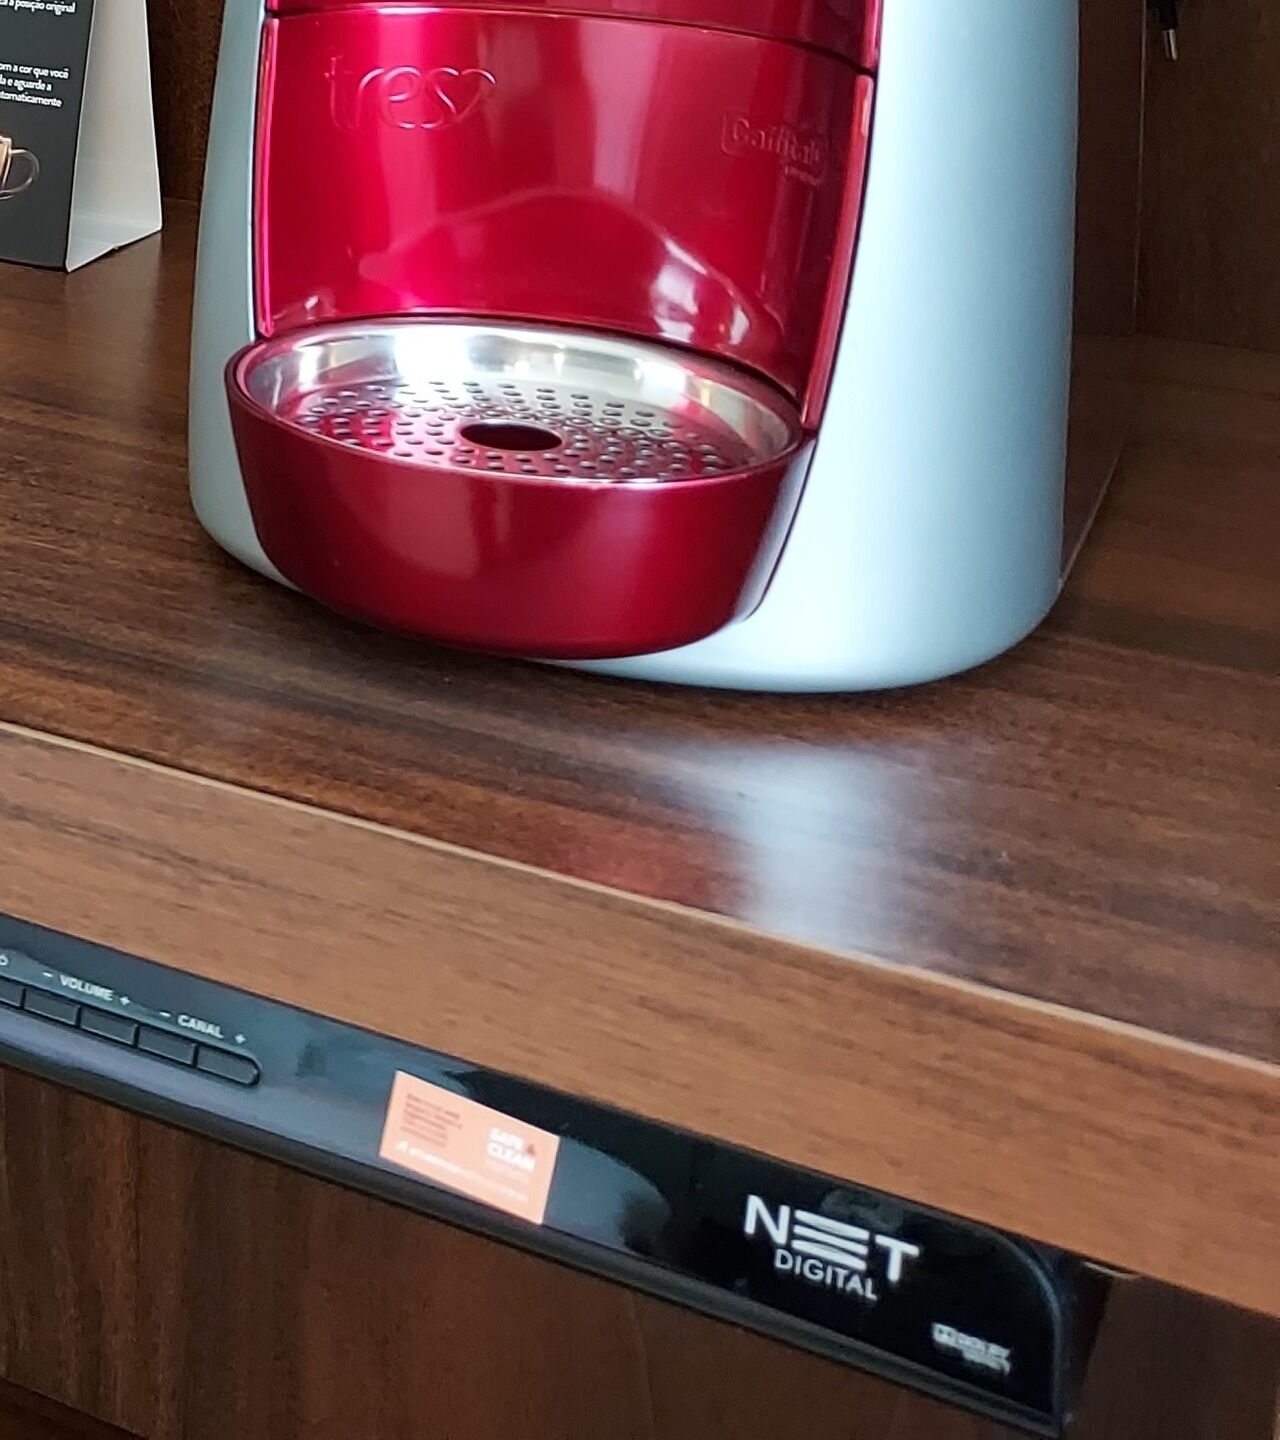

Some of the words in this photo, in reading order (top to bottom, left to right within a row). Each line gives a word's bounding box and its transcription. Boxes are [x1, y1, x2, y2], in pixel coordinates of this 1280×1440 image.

[19, 65, 33, 73] cor
[33, 66, 49, 78] que
[59, 974, 114, 1003] VOLUME
[176, 1013, 225, 1039] CANAL
[743, 1193, 921, 1284] NET
[774, 1248, 878, 1302] DIGITAL
